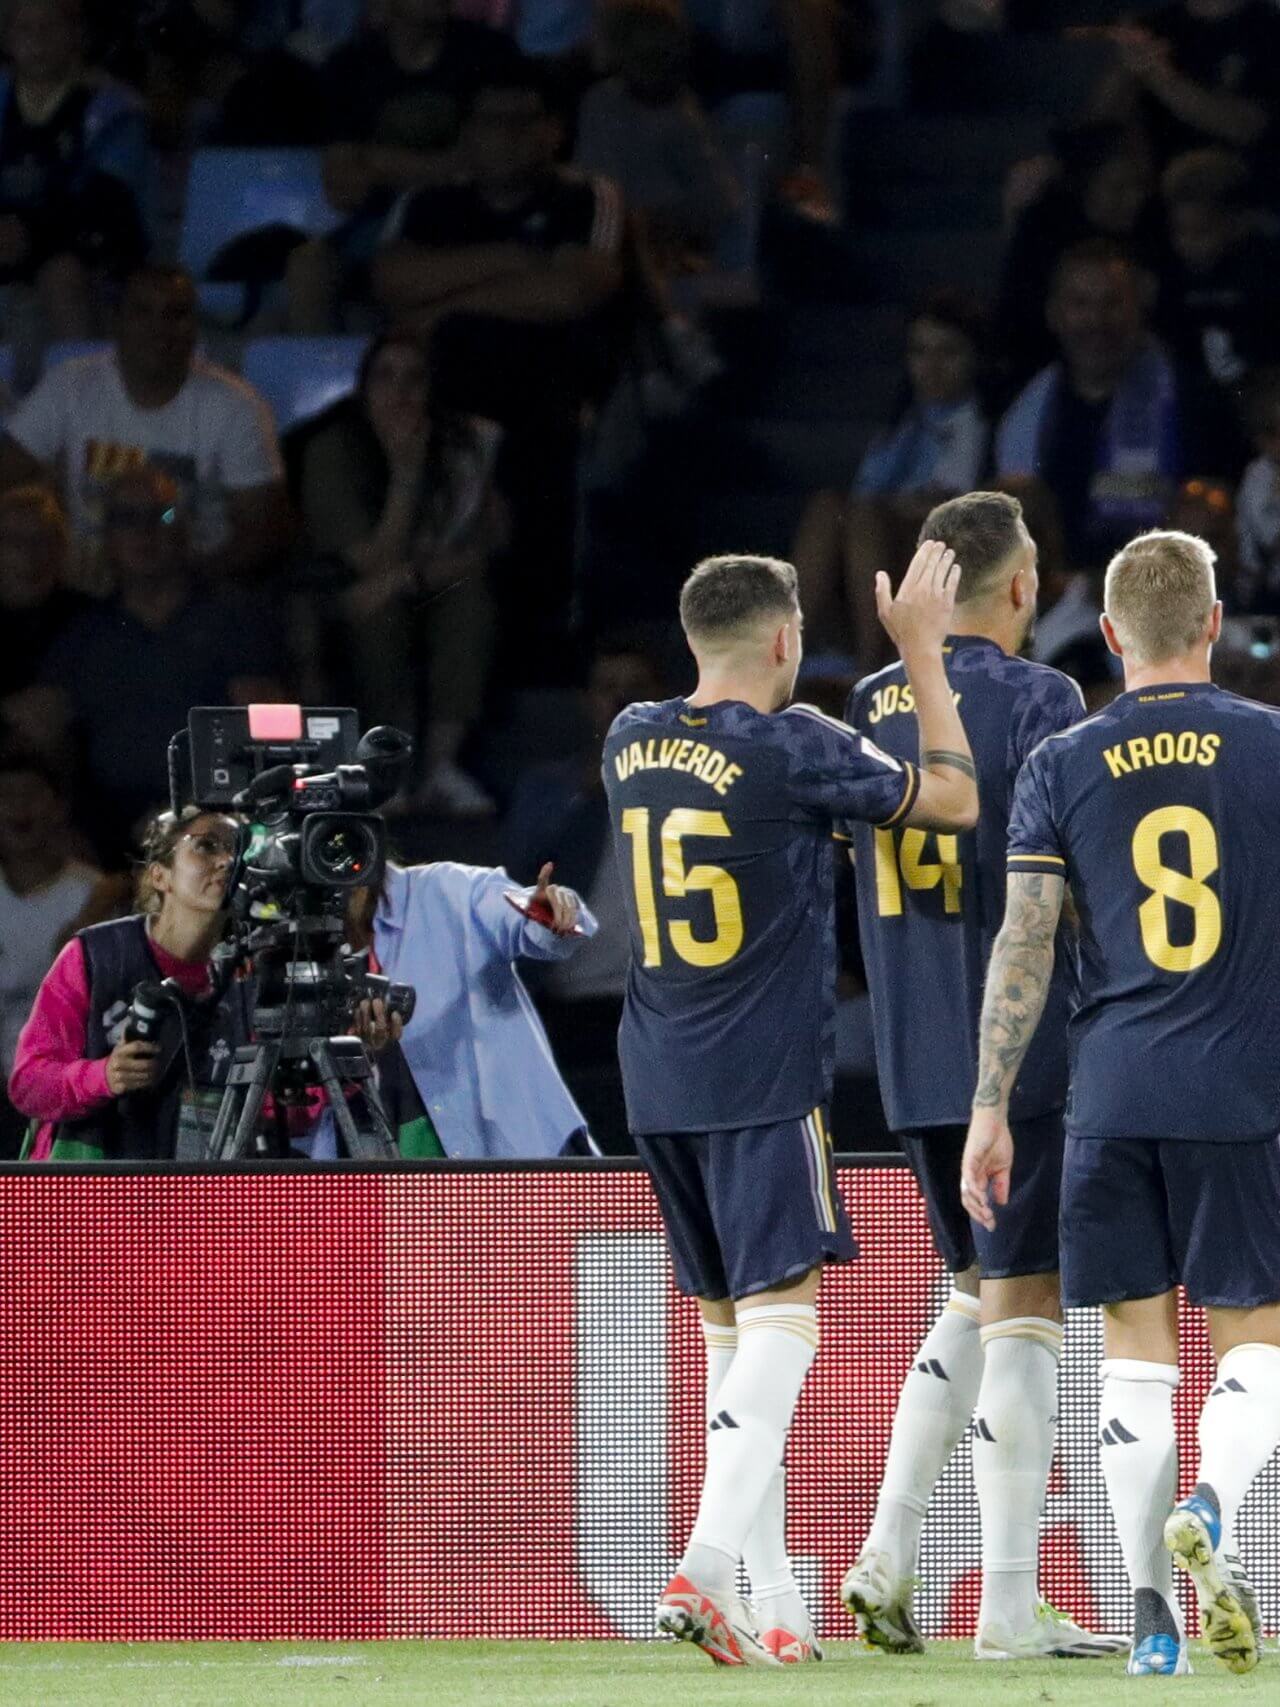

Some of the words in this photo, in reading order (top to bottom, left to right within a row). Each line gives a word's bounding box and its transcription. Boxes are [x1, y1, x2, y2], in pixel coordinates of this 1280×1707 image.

[615, 738, 743, 796] VALVERDE
[1103, 731, 1221, 779] KROOS
[622, 806, 743, 968] 15
[874, 827, 962, 916] 14
[1132, 805, 1222, 972] 8
